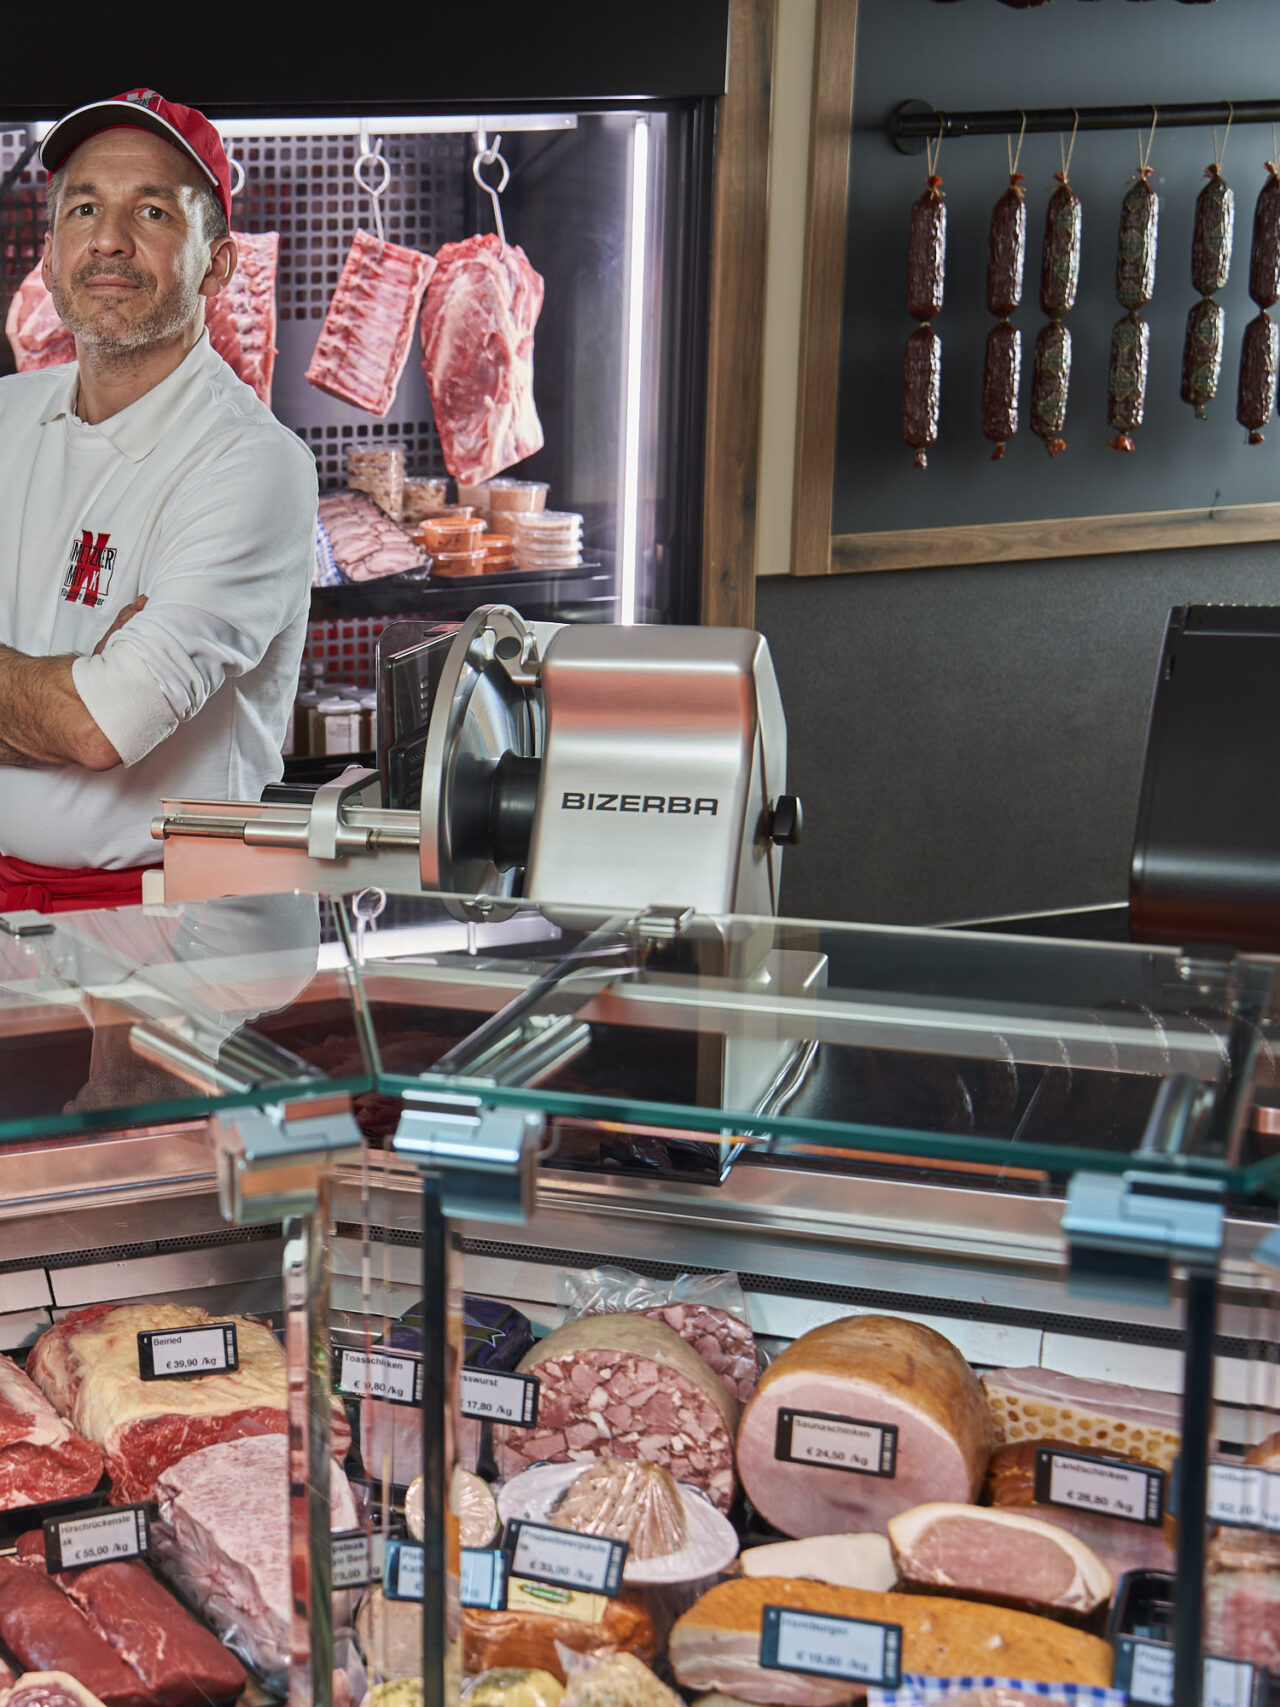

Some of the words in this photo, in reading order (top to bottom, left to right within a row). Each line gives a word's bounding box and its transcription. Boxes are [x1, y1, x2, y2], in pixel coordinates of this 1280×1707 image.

[71, 541, 115, 571] METZKER
[65, 565, 85, 587] MIT
[561, 792, 719, 816] BIZERBA
[153, 1337, 182, 1346] Beiried
[166, 1361, 172, 1369] €
[174, 1358, 198, 1368] 39,90
[202, 1357, 217, 1366] /kg
[354, 1380, 360, 1388] €
[387, 1386, 404, 1397] /kg
[460, 1374, 498, 1386] sswurst
[467, 1400, 493, 1412] 17,80
[496, 1405, 513, 1417] /kg
[795, 1420, 871, 1438] Saunaschinken
[806, 1447, 813, 1456] €
[816, 1448, 845, 1461] 24,50
[850, 1454, 868, 1466] /kg
[75, 1551, 82, 1559] €
[83, 1545, 109, 1557] 55,00
[113, 1542, 129, 1552] /kg
